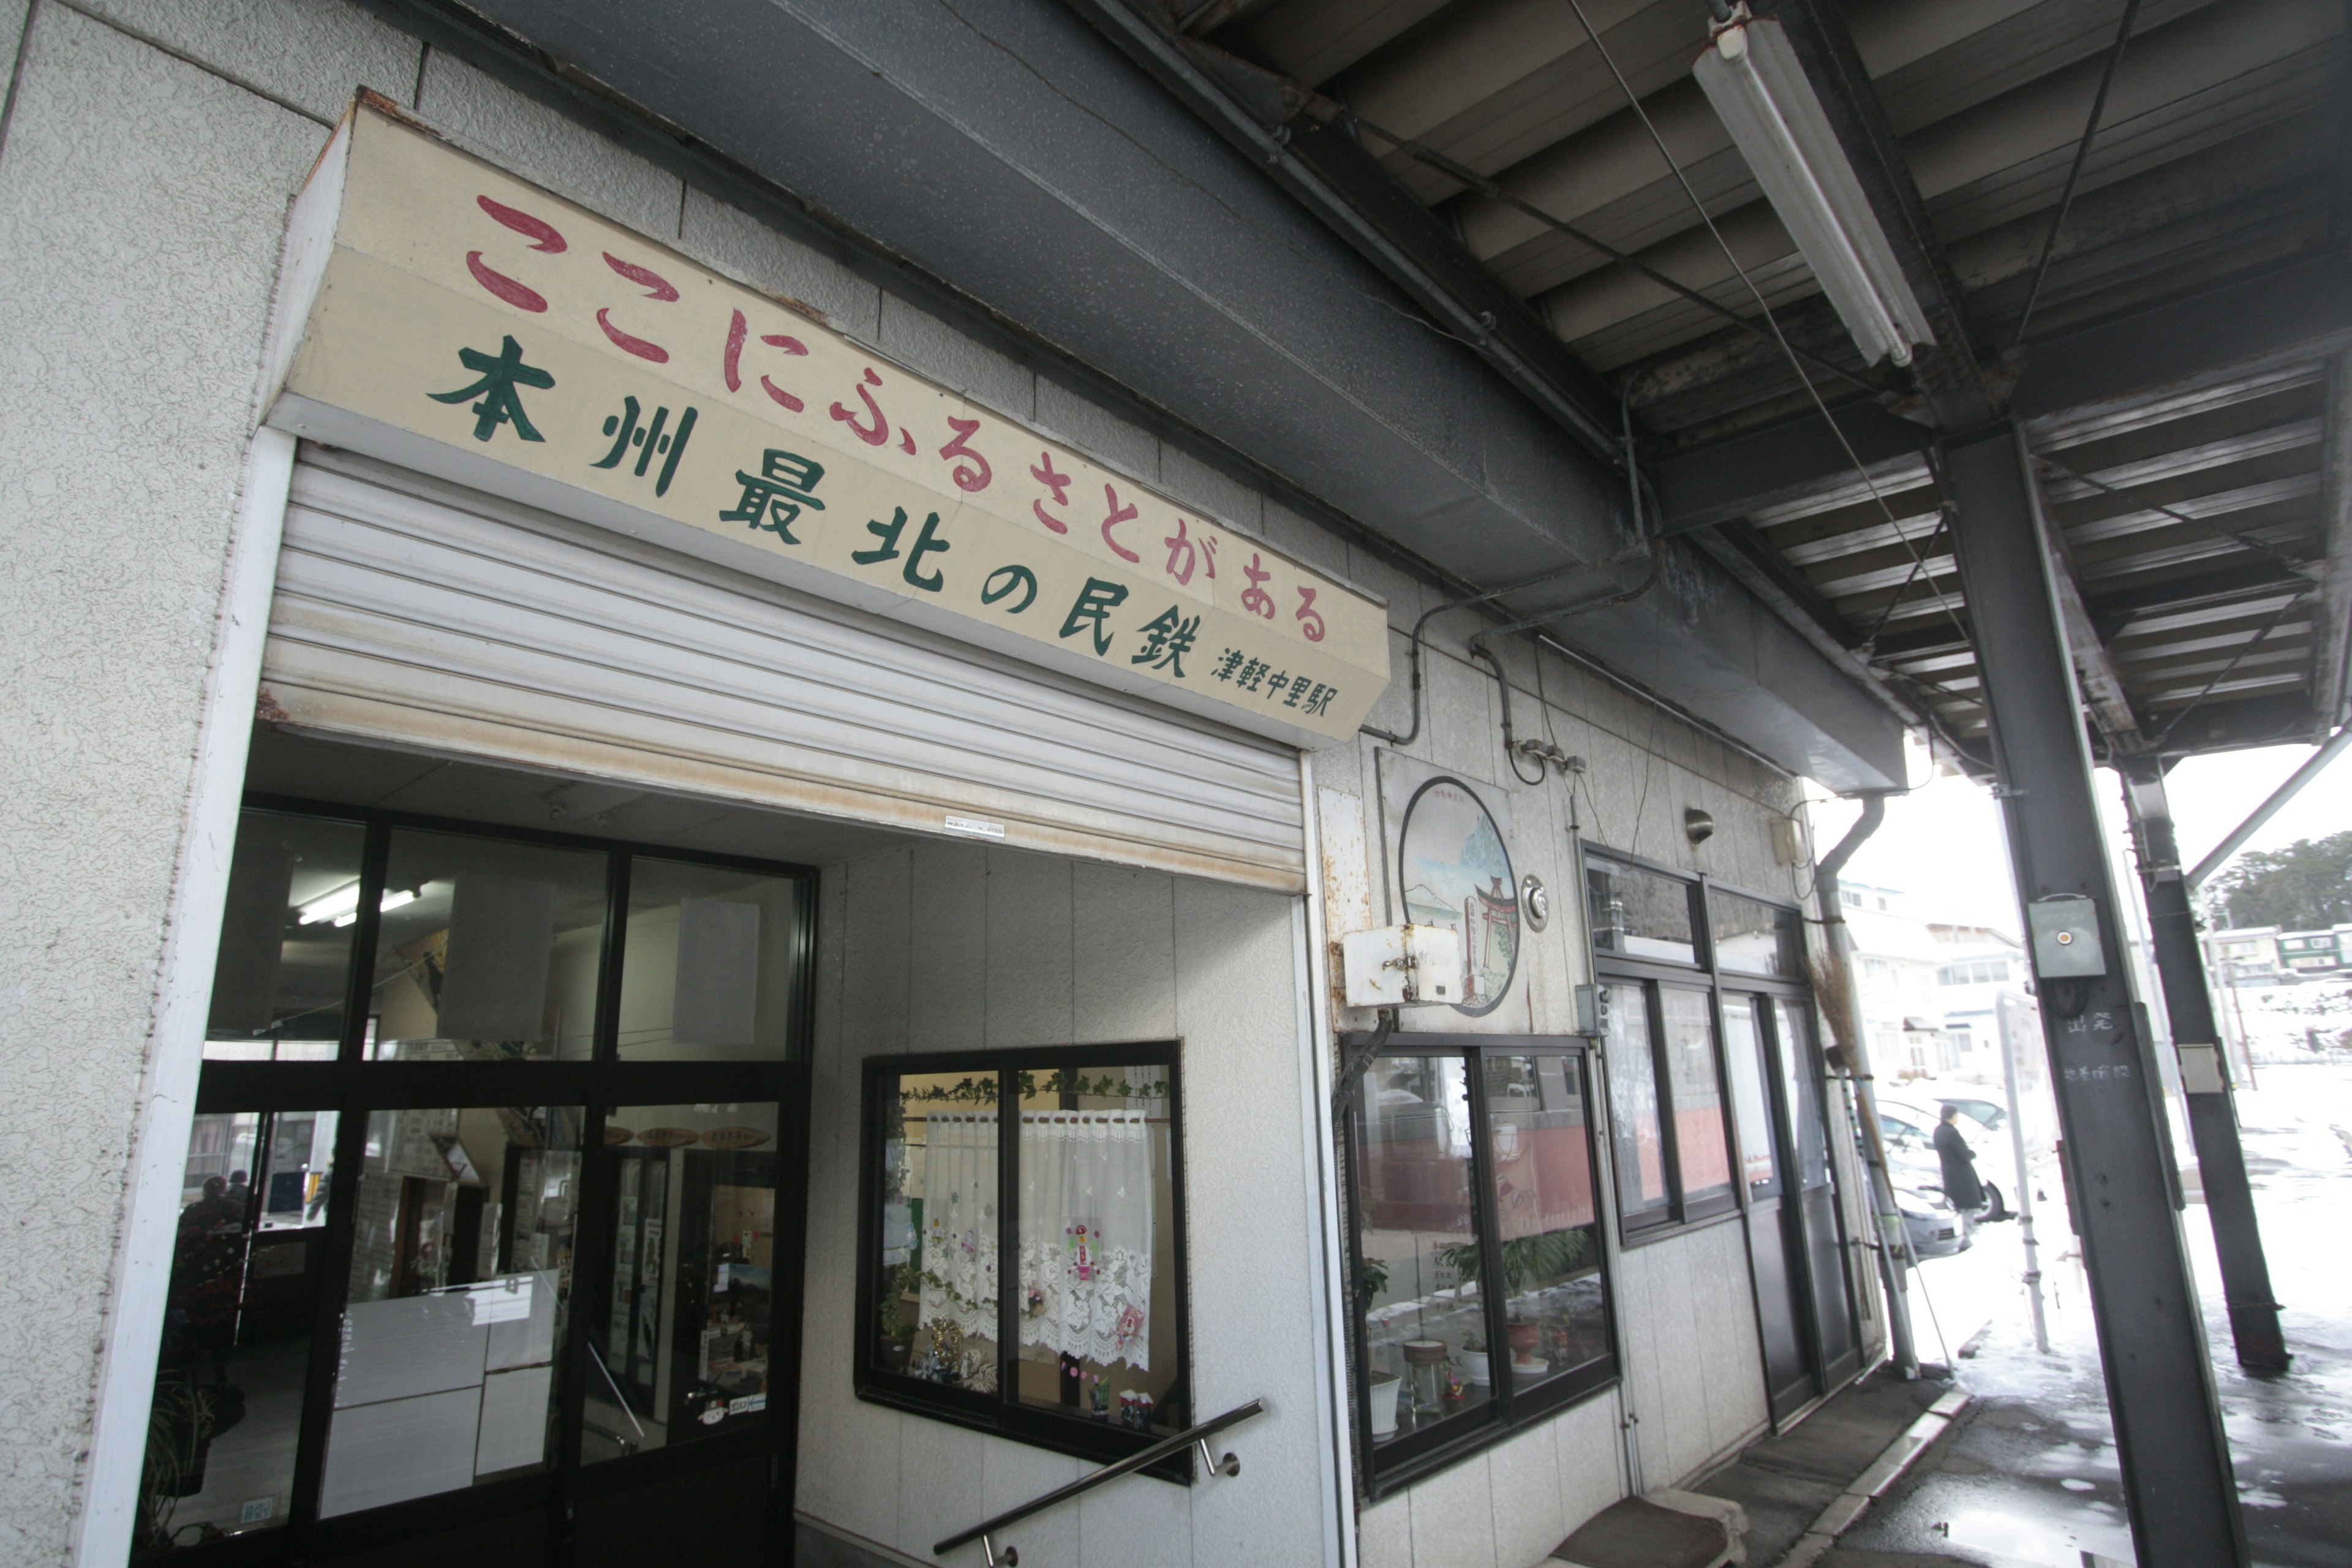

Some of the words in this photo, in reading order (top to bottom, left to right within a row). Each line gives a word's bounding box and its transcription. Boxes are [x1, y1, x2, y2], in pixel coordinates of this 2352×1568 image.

[426, 334, 1202, 679] 本州最北の民鉄
[466, 194, 1326, 643] ここにふるさとがある
[1210, 647, 1338, 717] 津軽中里駅
[2067, 1012, 2114, 1034] 出発
